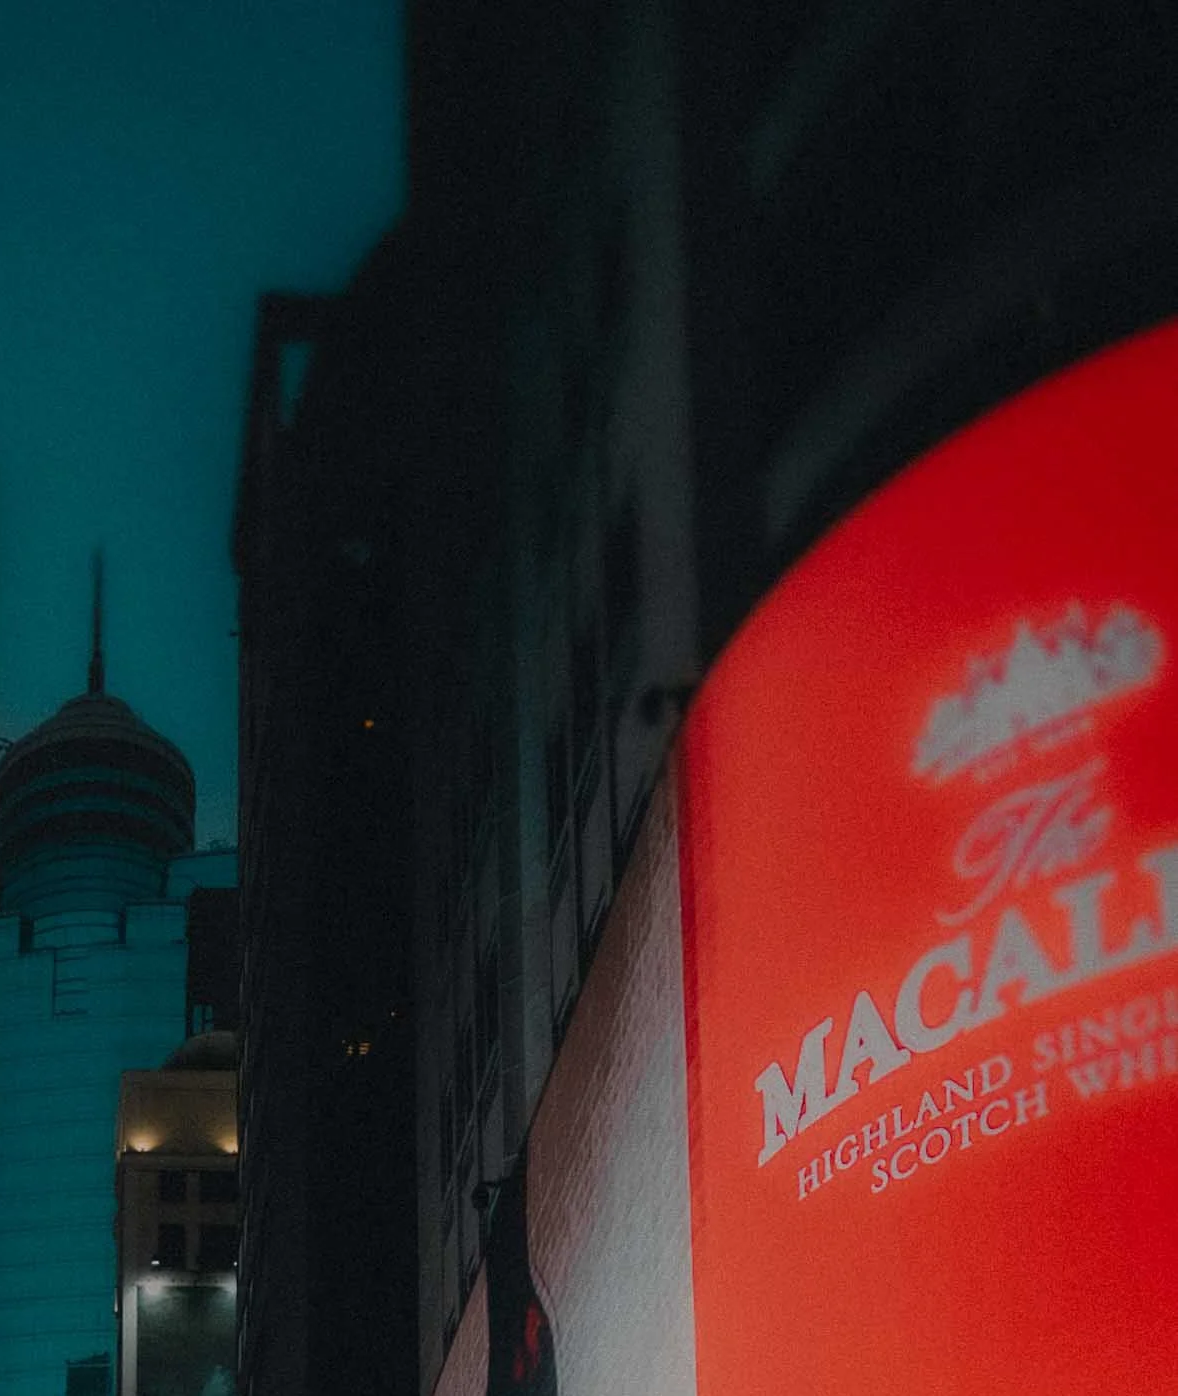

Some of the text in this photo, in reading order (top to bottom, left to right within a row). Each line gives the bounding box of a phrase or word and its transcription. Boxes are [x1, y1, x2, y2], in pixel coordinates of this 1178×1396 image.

[934, 757, 1114, 926] The
[797, 1054, 1013, 1201] HIGHLAND
[870, 1083, 1051, 1194] SCOTCH
